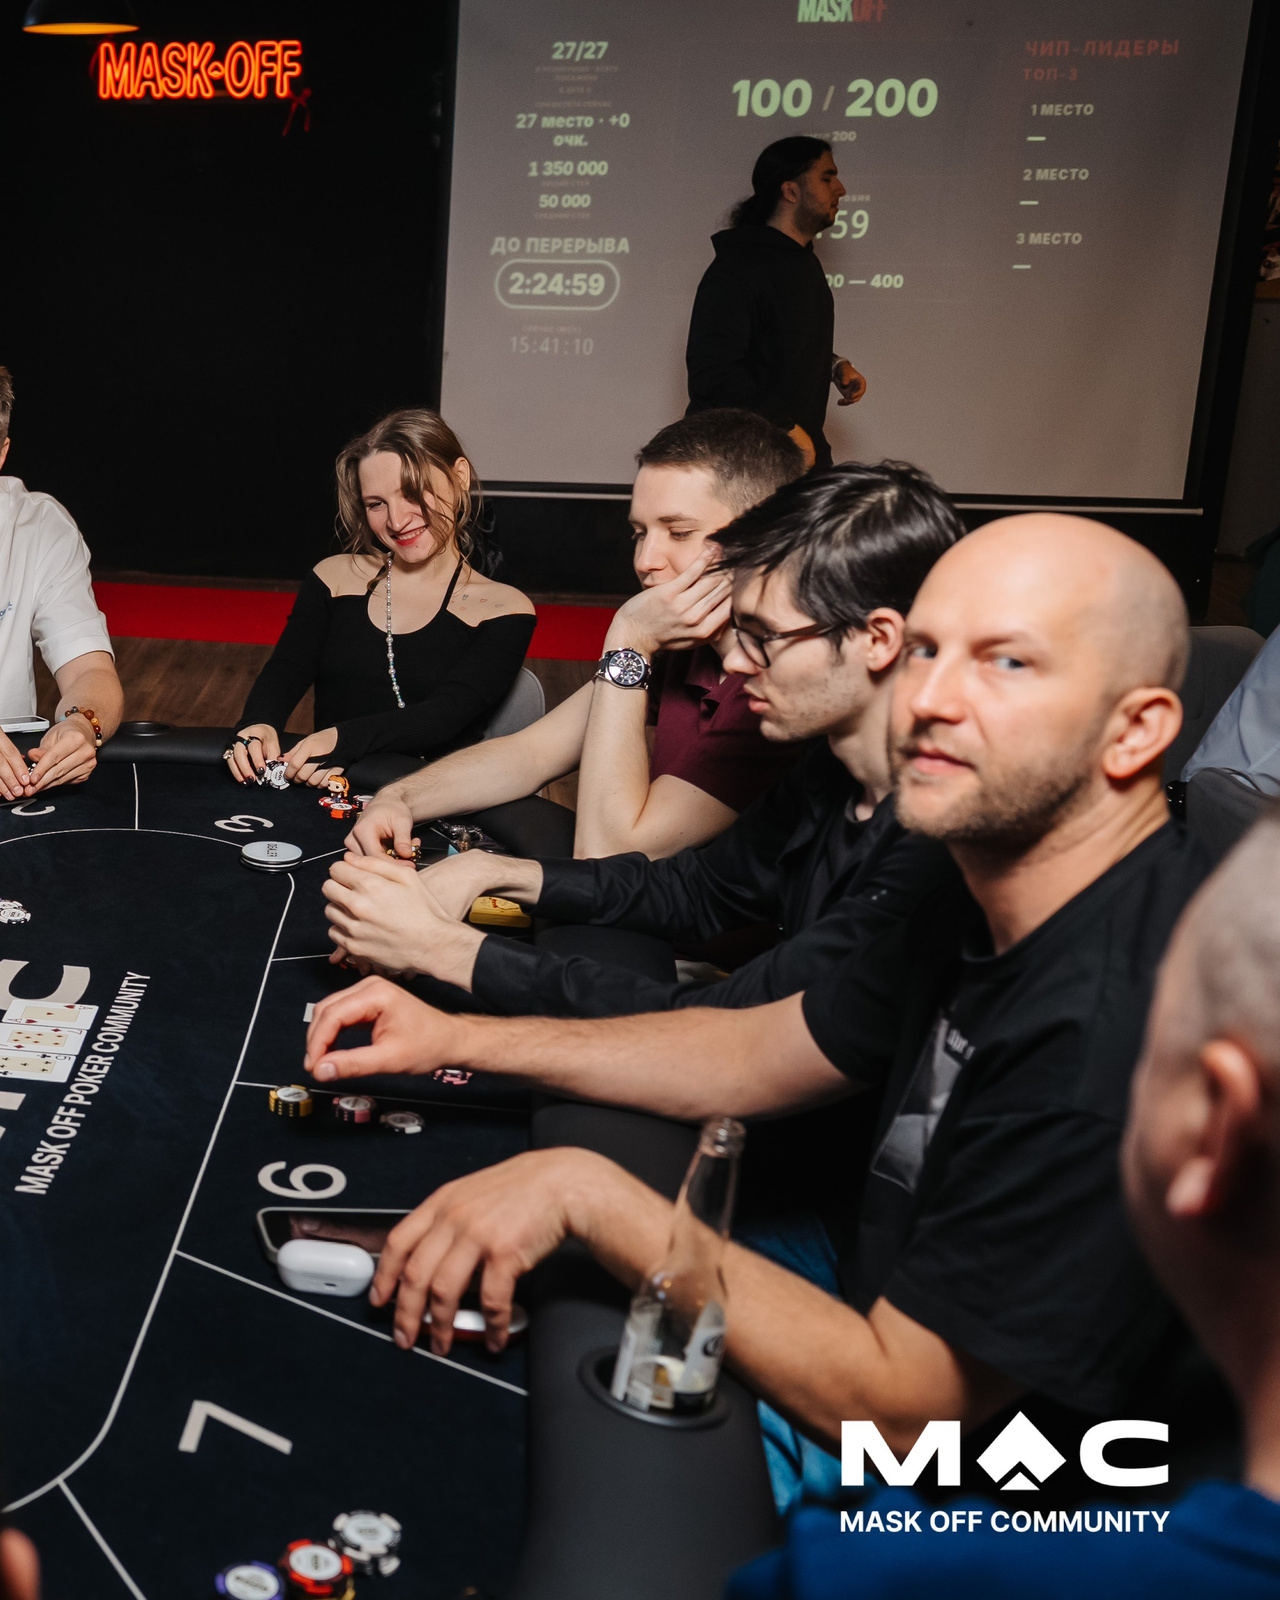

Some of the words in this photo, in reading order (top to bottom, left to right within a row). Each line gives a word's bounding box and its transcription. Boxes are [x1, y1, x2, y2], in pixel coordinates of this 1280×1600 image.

[551, 41, 609, 61] 27/27
[1025, 39, 1179, 58] ЧИП-ЛИДЕРЫ
[1023, 67, 1078, 81] ТОП-3
[732, 78, 813, 118] 100
[845, 78, 938, 118] 200
[1030, 103, 1038, 116] 1
[1040, 103, 1094, 116] МЕСТО
[516, 113, 538, 129] 27
[541, 116, 594, 129] место
[609, 112, 631, 128] +0
[553, 134, 588, 147] очк.
[831, 131, 857, 141] 200
[528, 161, 538, 177] 1
[542, 160, 574, 176] 350
[577, 160, 609, 176] 000
[1022, 168, 1032, 181] 2
[1035, 168, 1090, 181] МЕСТО
[539, 194, 559, 208] 50
[561, 194, 592, 208] 000
[490, 236, 520, 256] ДО
[525, 236, 630, 254] ПЕРЕРЫВА
[1016, 232, 1026, 245] 3
[1028, 232, 1083, 245] МЕСТО
[508, 271, 605, 296] 2:24:59
[825, 274, 844, 288] 00
[870, 274, 904, 288] 400
[510, 335, 595, 356] 15:41:10
[214, 814, 274, 833] 3
[91, 971, 151, 1053] COMMUNITY
[63, 1054, 115, 1105] POKER
[46, 1106, 86, 1139] OFF
[14, 1140, 71, 1195] MASK
[258, 1161, 347, 1200] 6
[178, 1400, 293, 1455] 7
